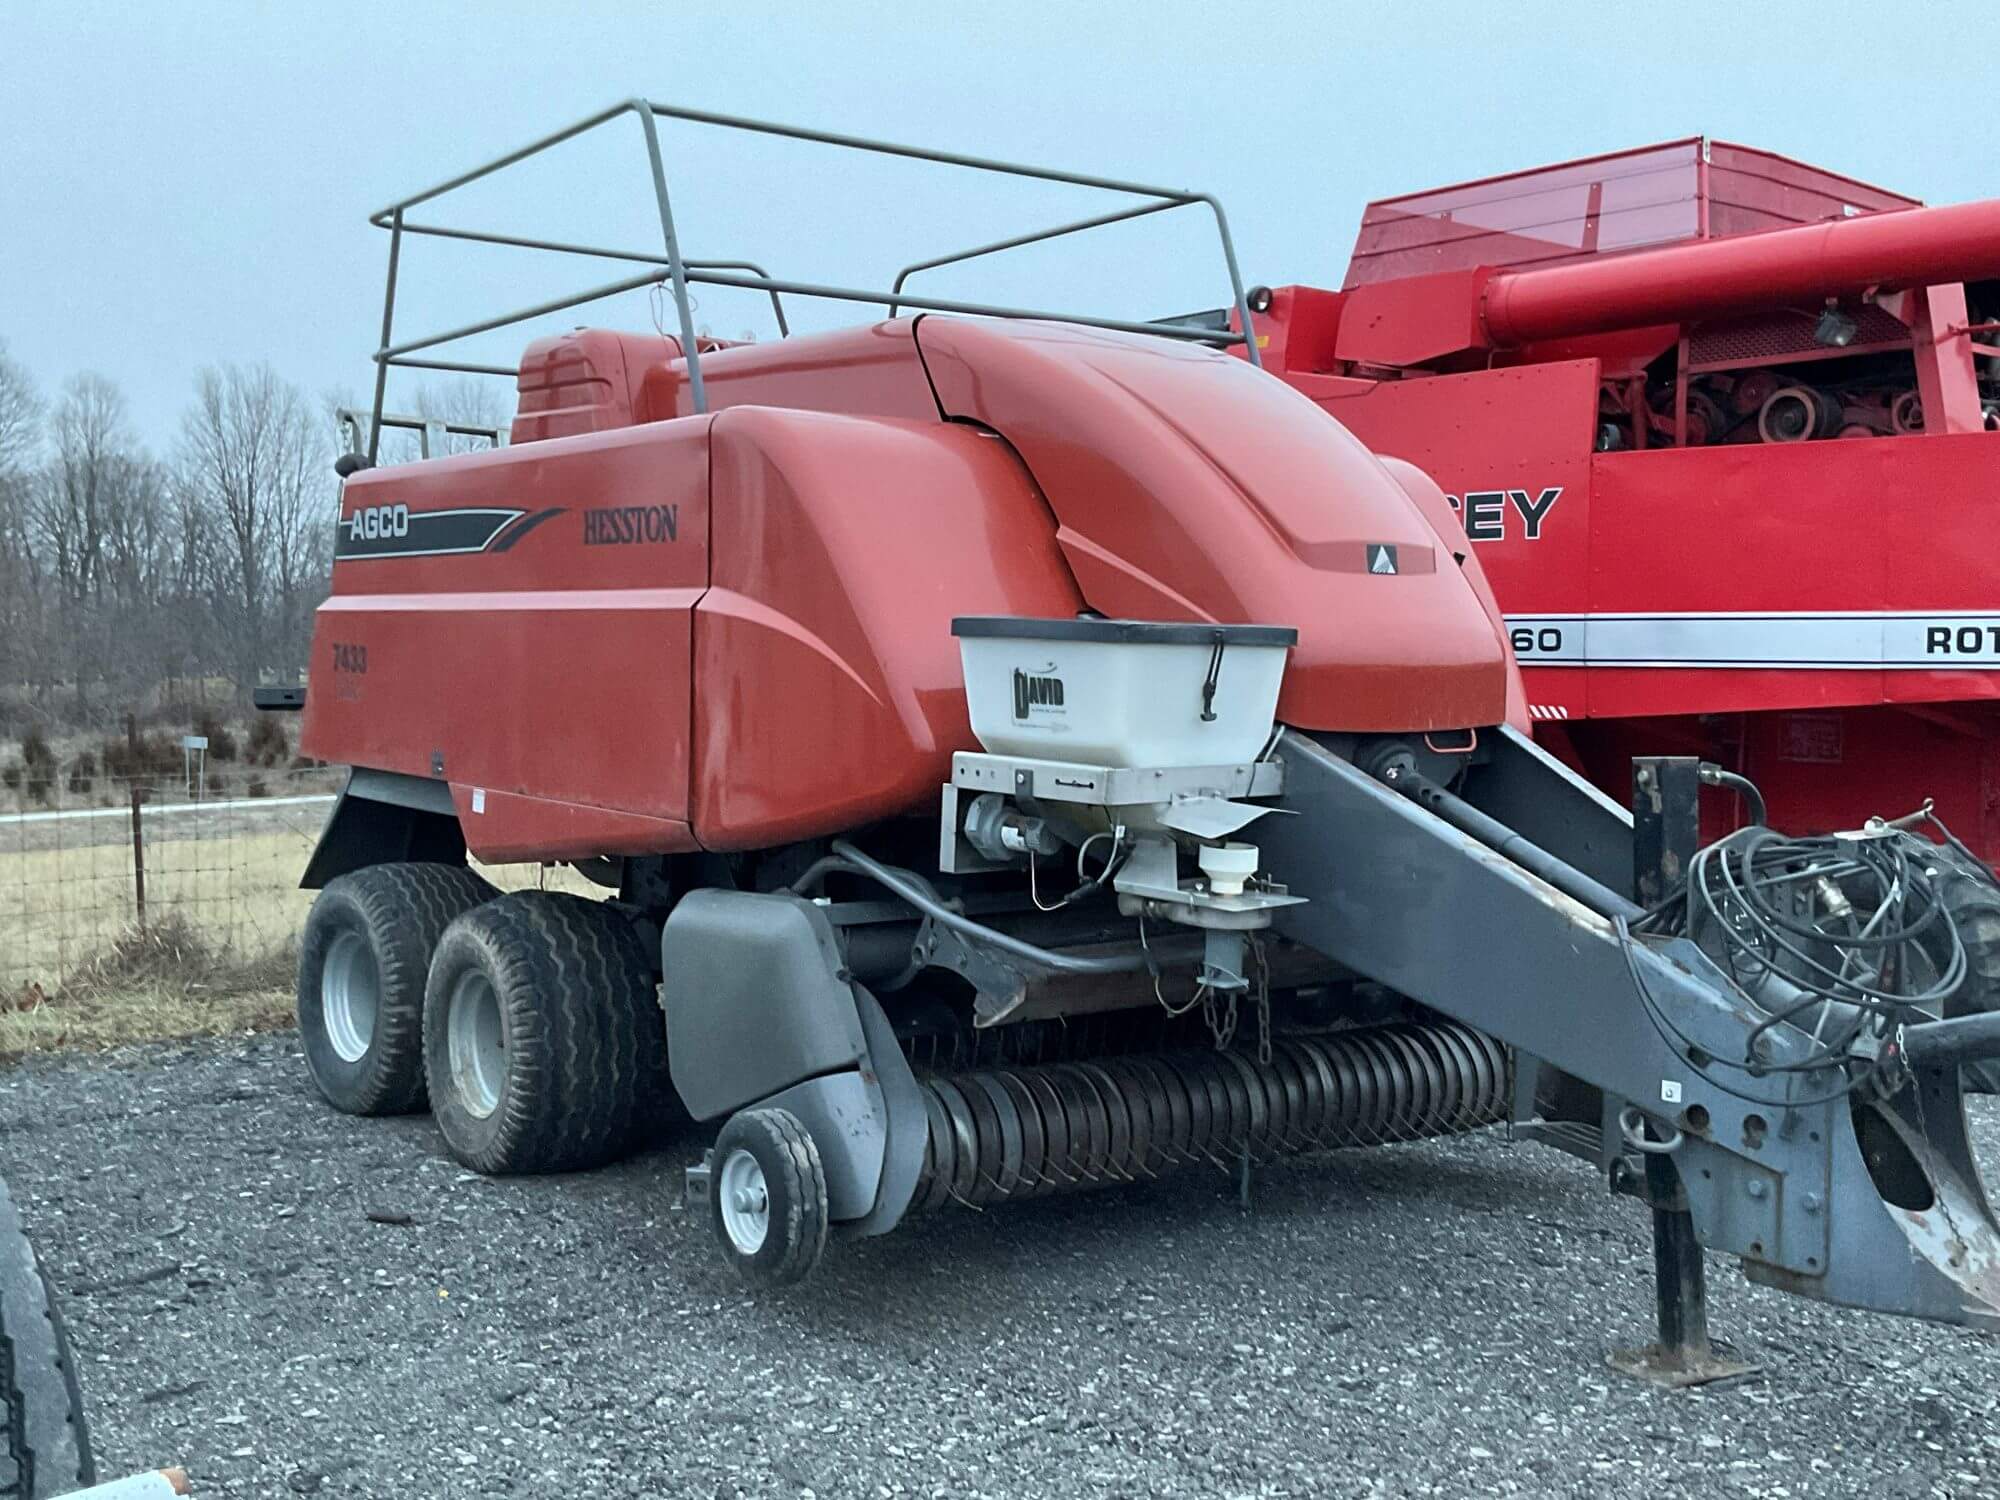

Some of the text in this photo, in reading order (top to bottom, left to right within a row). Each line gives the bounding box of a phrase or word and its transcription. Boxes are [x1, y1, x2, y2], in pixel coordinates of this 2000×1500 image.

[350, 504, 408, 540] AGCO
[583, 504, 678, 545] HESSTON
[332, 643, 367, 672] 7433
[1511, 628, 1562, 652] 60
[1013, 667, 1064, 719] DAVID
